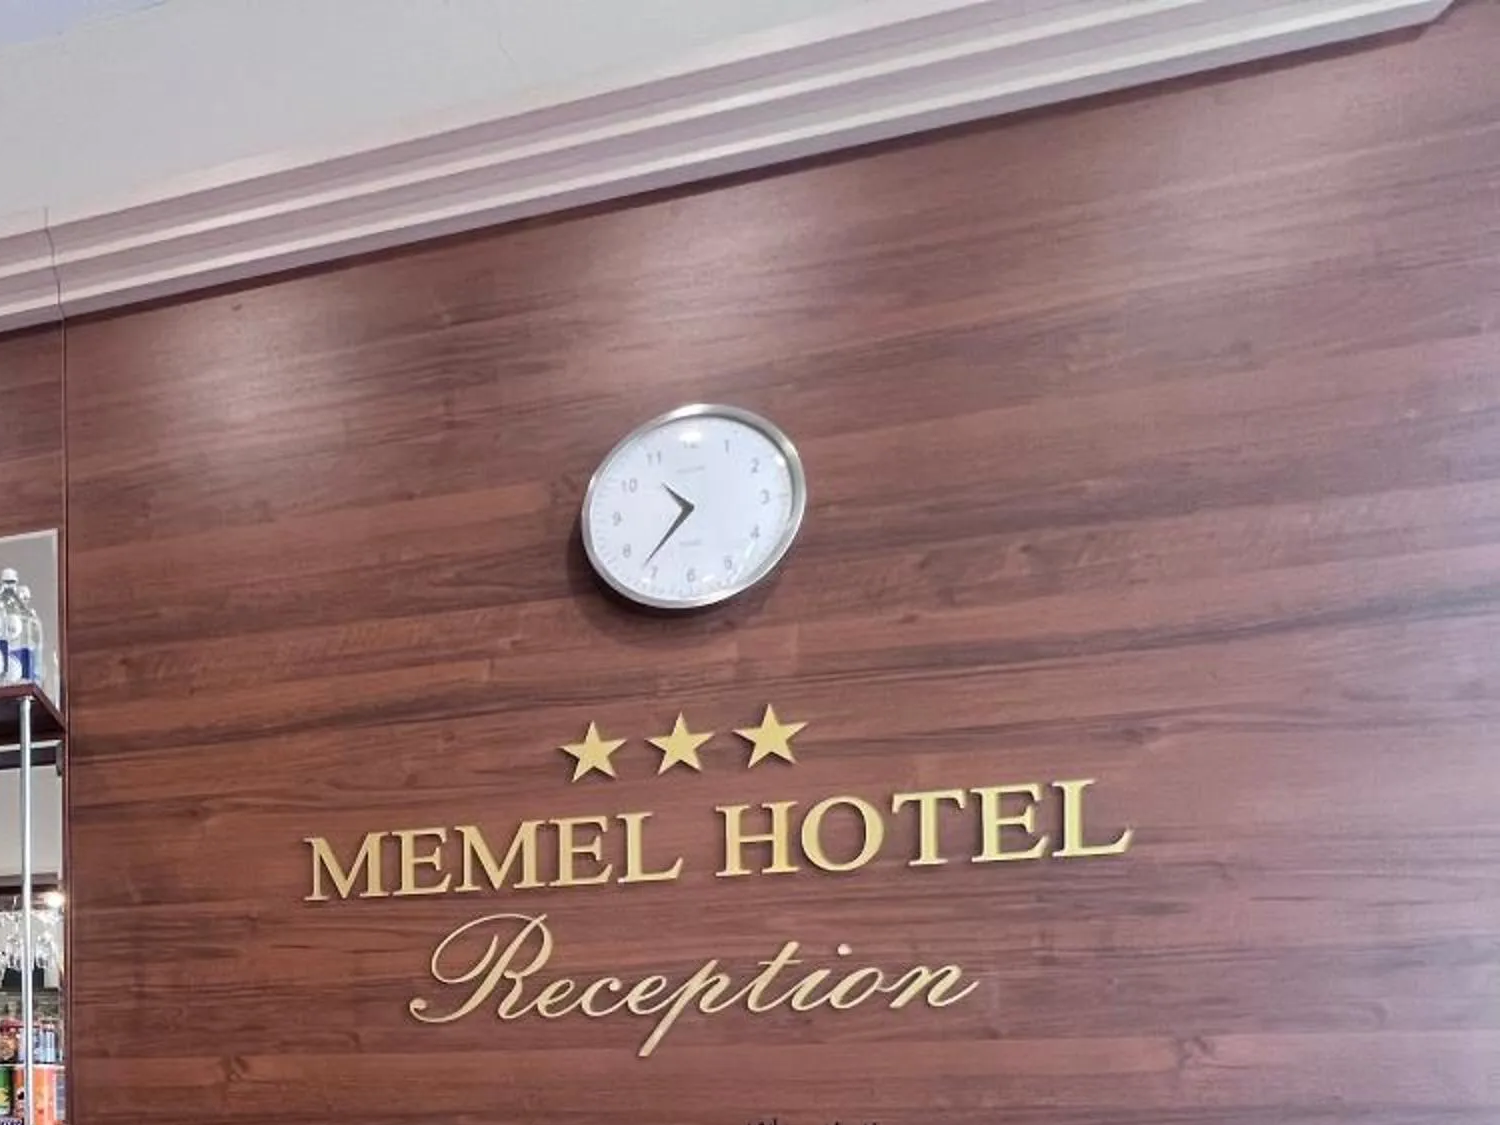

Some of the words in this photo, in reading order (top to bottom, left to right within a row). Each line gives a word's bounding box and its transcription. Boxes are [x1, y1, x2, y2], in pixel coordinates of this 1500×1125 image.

[749, 458, 760, 473] 2
[303, 810, 684, 901] MEMEL
[714, 778, 1136, 878] HOTEL
[408, 912, 981, 1058] Reception
